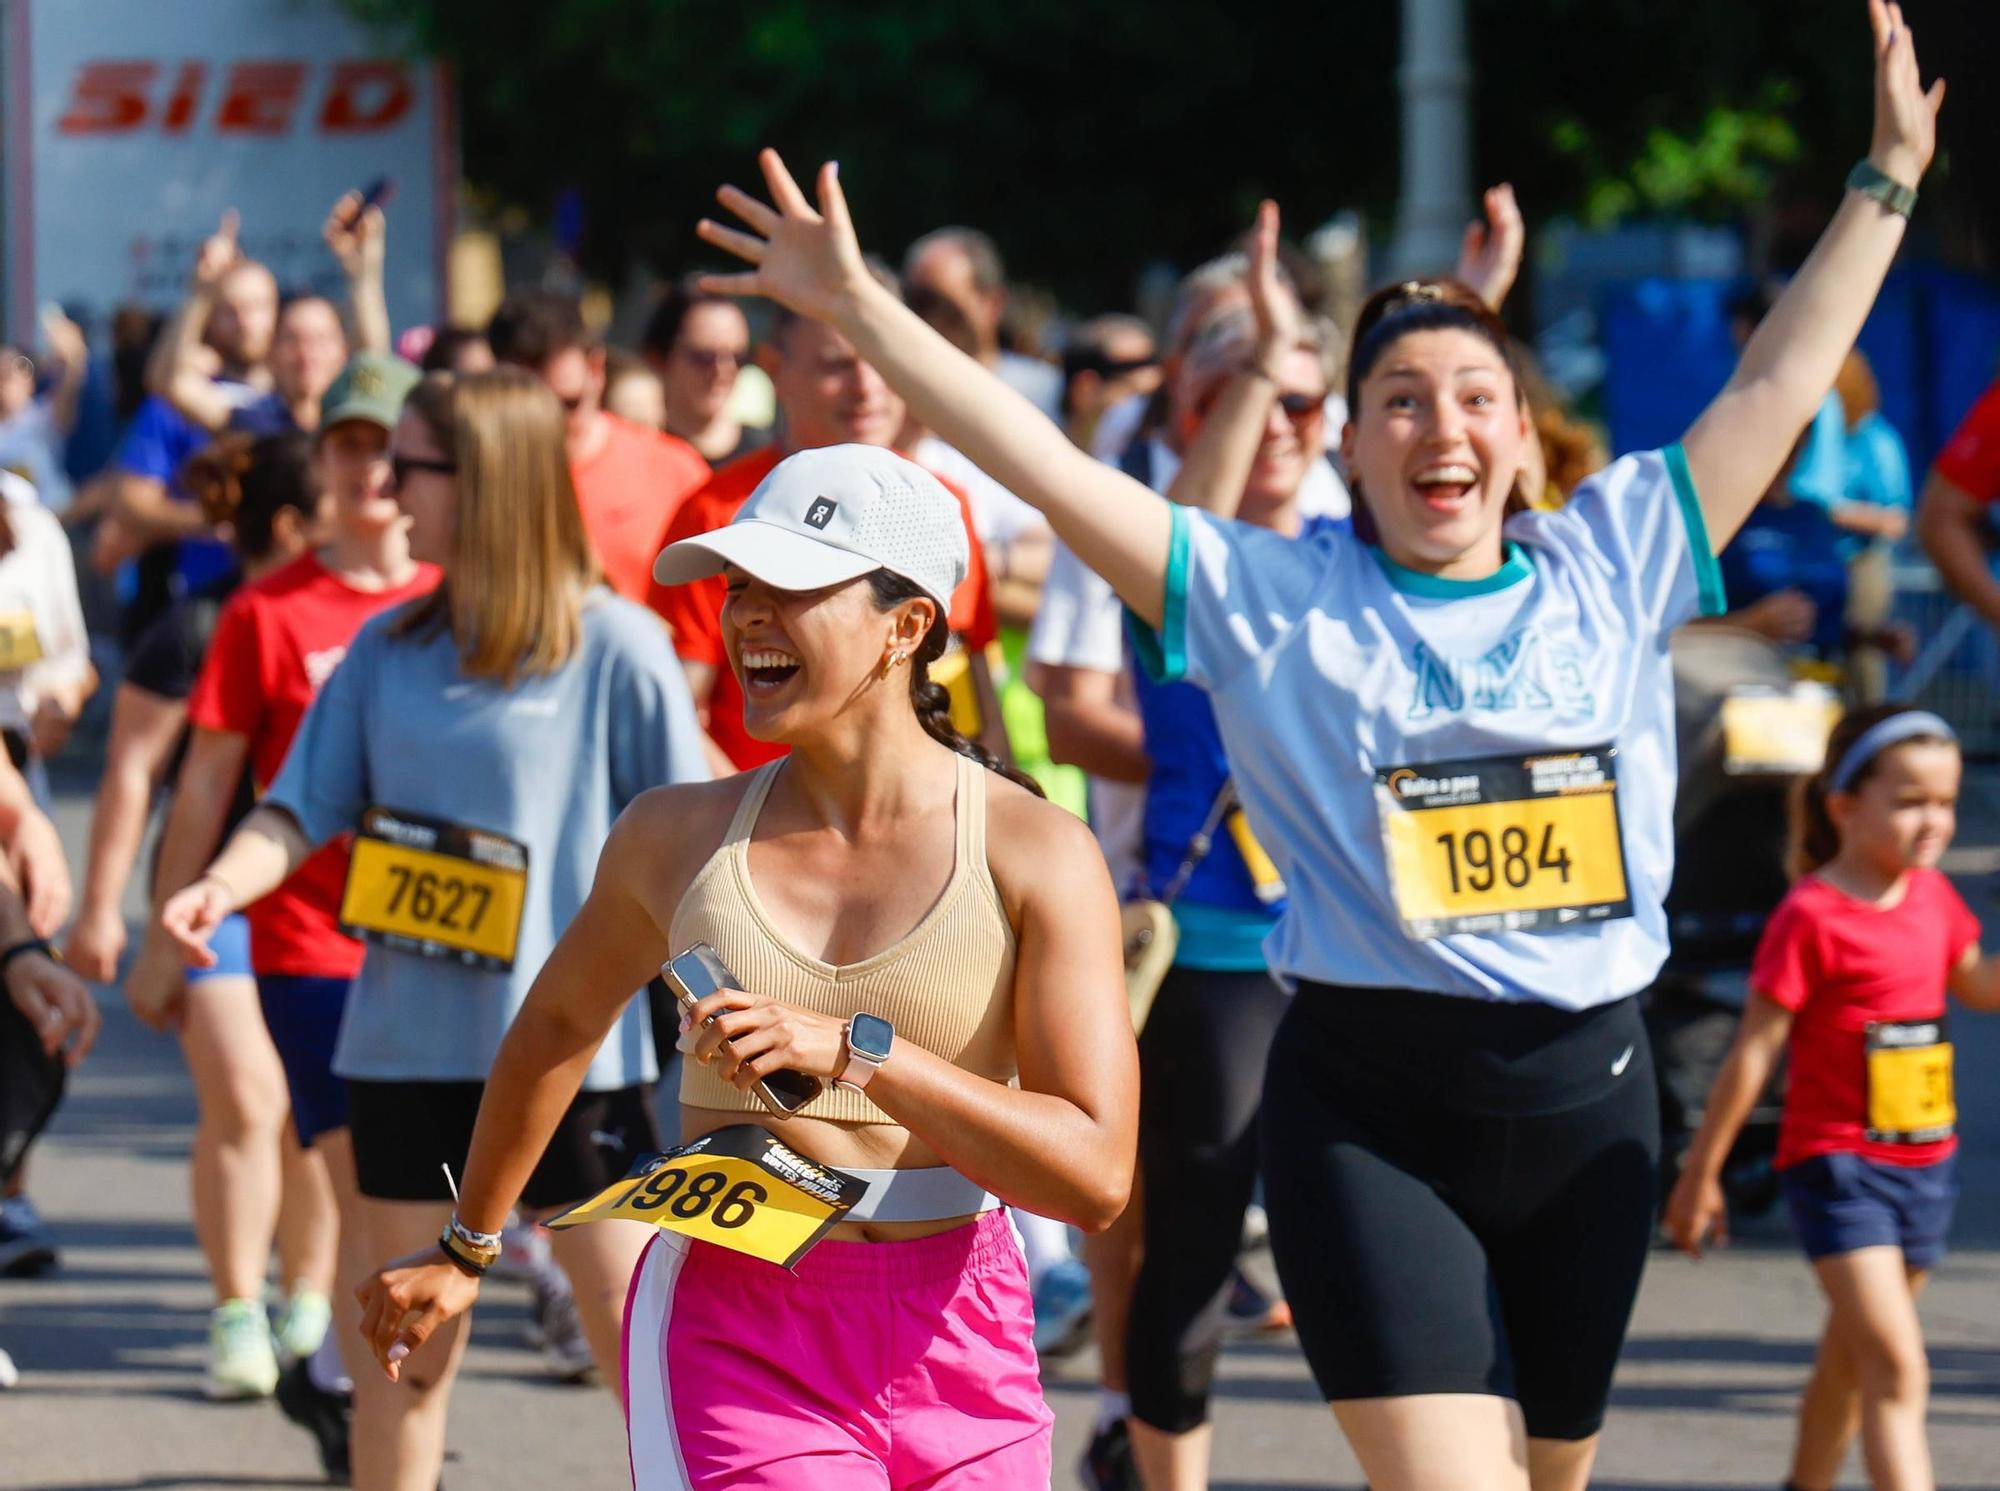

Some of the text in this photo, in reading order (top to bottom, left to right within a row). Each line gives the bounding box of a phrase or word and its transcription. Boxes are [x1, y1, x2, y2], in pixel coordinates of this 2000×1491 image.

[1437, 822, 1572, 894] 1984
[385, 864, 495, 933] 7627
[612, 1168, 768, 1230] 1986
